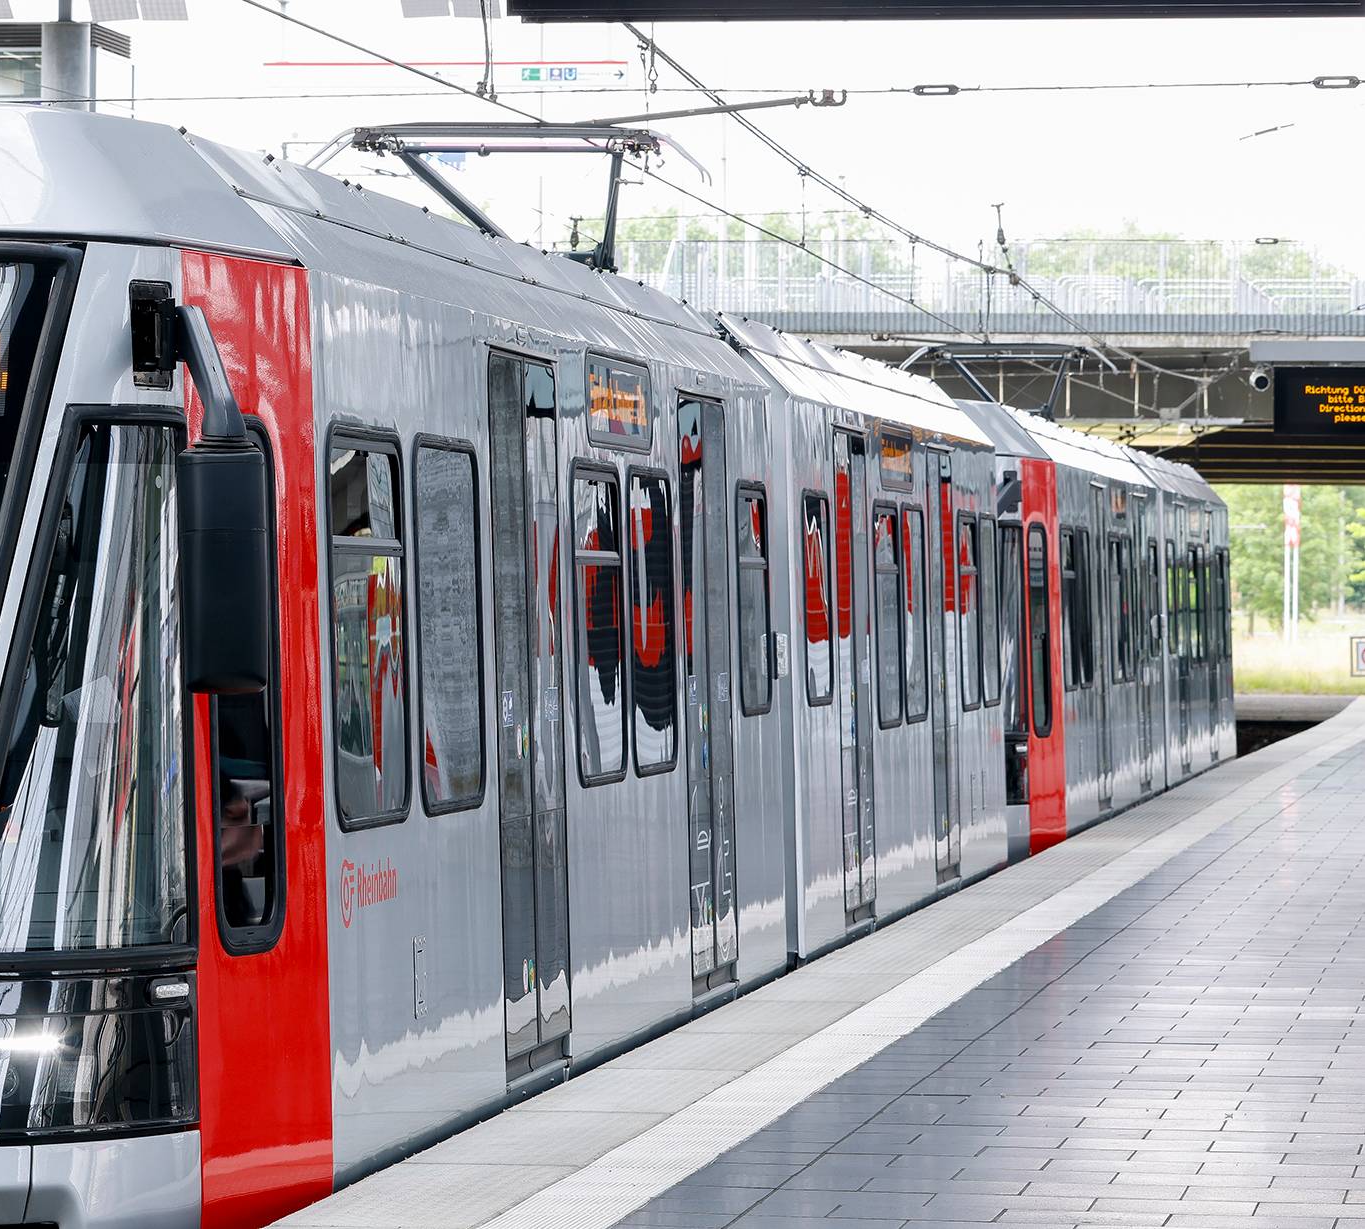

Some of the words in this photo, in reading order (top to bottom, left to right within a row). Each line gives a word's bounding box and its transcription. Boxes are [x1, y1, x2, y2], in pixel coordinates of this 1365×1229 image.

[1305, 385, 1350, 396] Richtung
[1328, 395, 1354, 404] bitte
[357, 856, 398, 909] Rheinbahn
